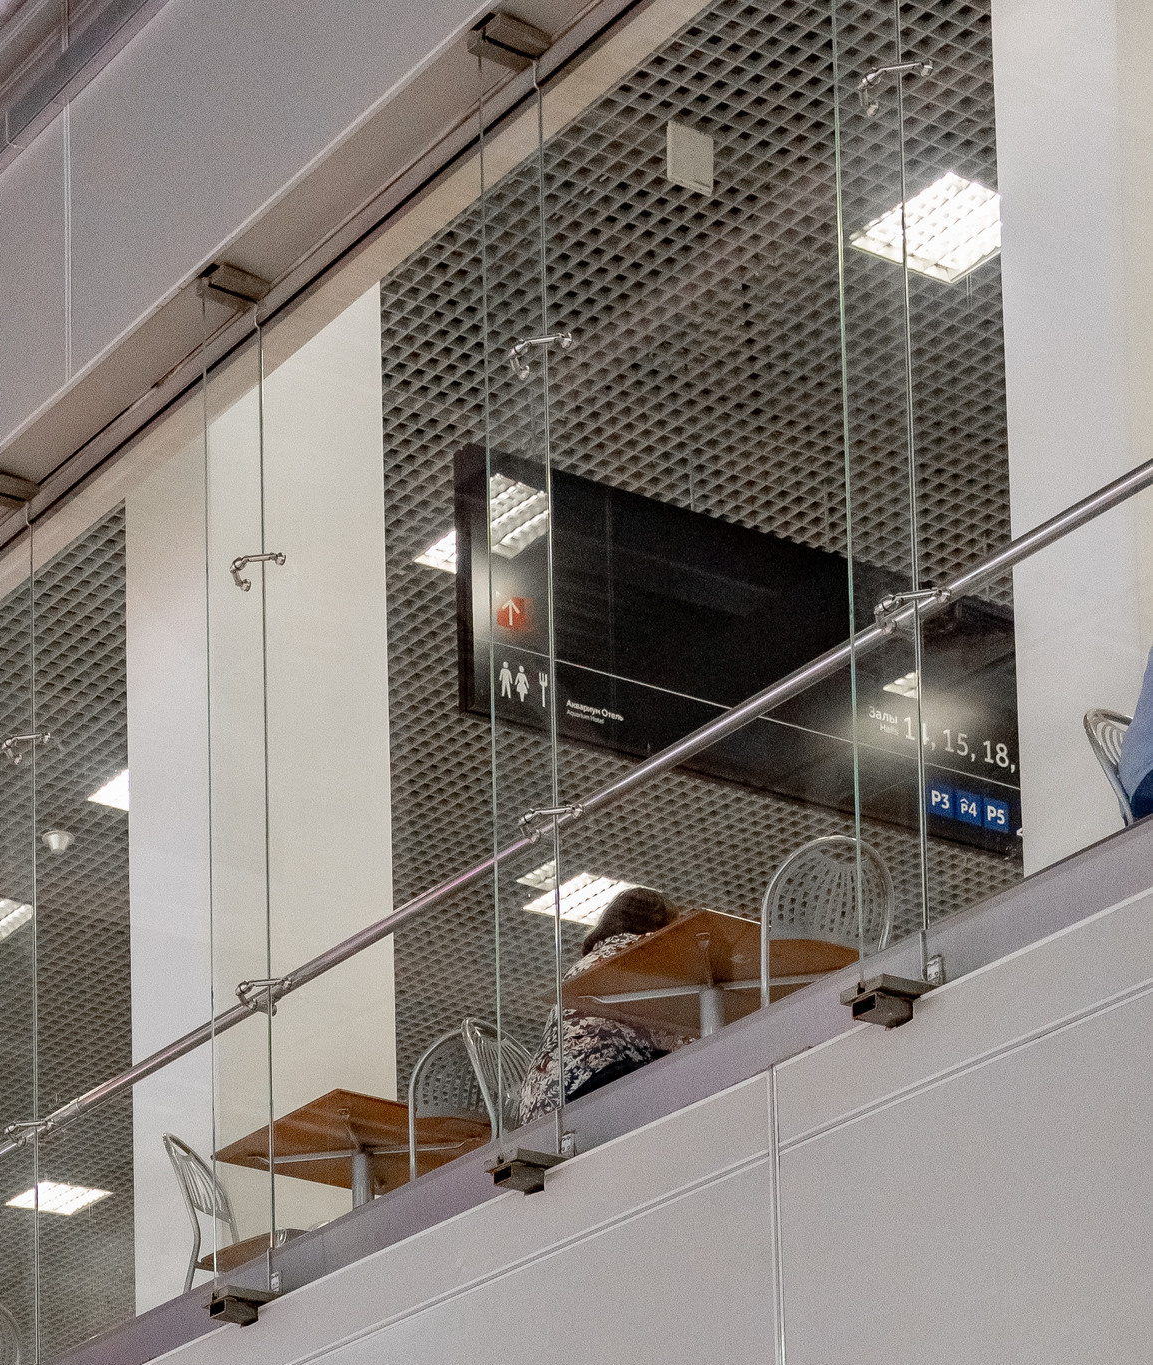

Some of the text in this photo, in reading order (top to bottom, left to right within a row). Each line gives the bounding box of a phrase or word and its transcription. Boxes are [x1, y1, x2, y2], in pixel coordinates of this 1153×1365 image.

[566, 700, 624, 721] Аквариум Отель
[868, 706, 898, 724] Залы
[943, 729, 976, 762] 15,
[983, 740, 1016, 773] 18,
[931, 789, 950, 809] P3
[987, 805, 1005, 825] P5
